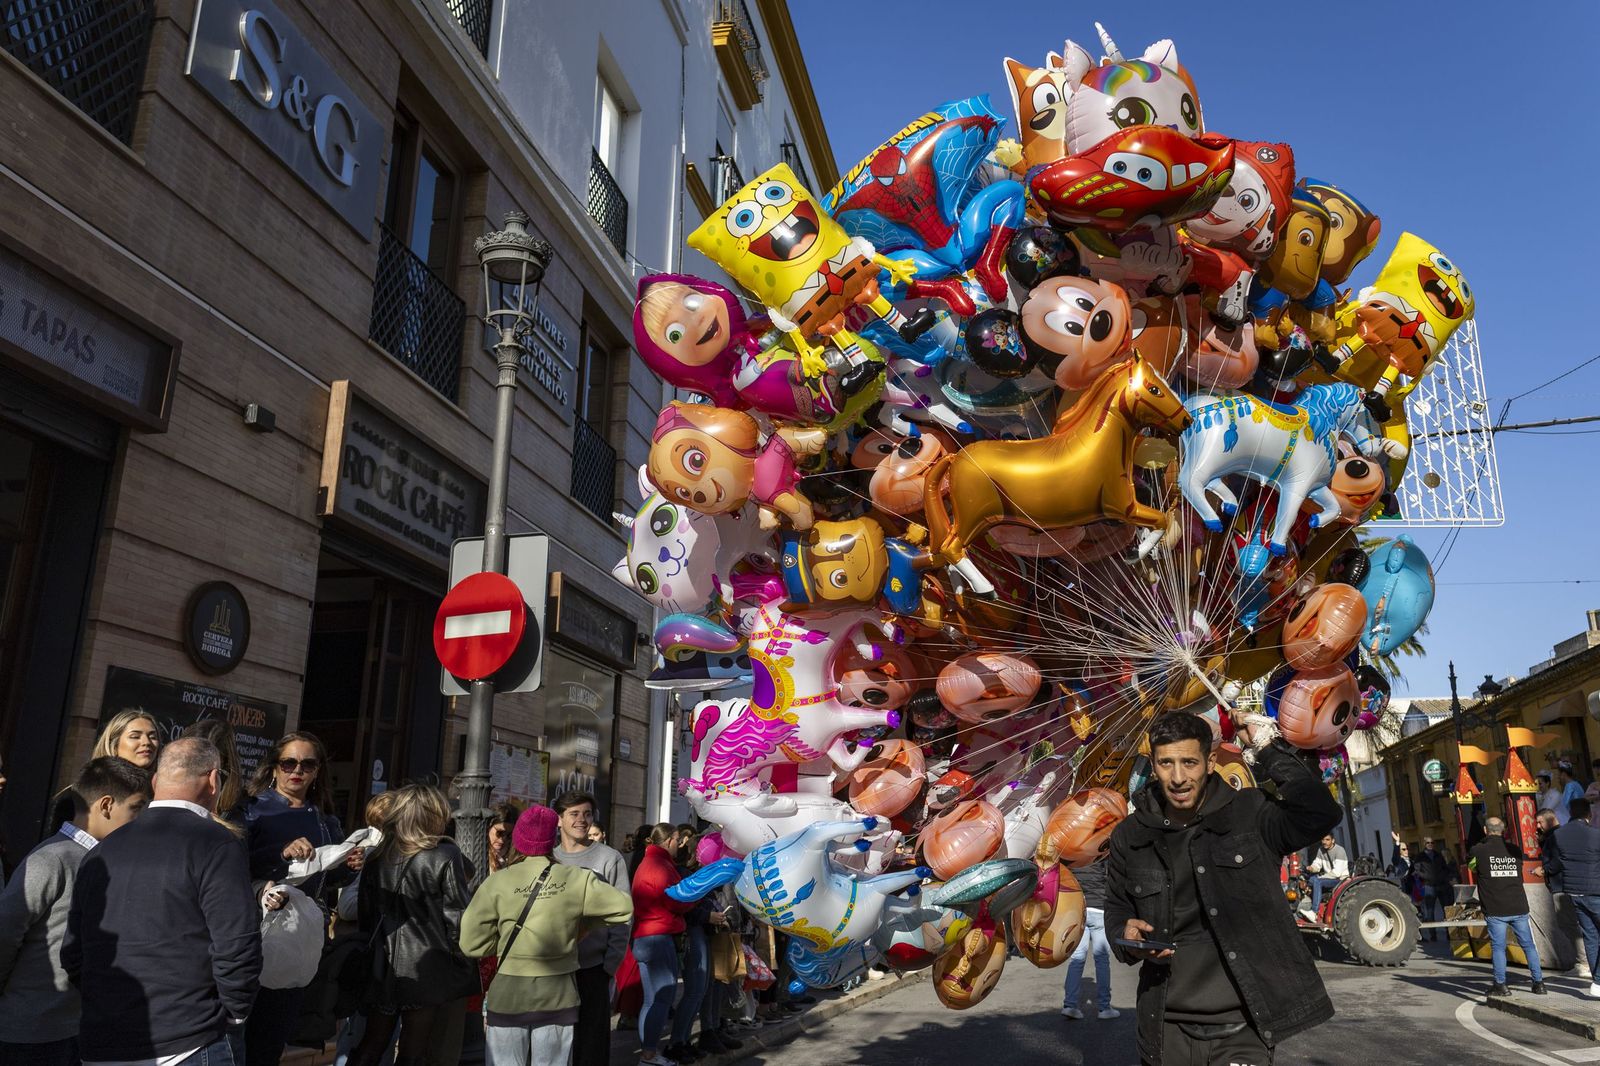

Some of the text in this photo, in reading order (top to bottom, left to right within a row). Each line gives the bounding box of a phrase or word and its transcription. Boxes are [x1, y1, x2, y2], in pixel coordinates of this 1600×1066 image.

[229, 9, 361, 188] S&G
[21, 298, 96, 364] TAPAS
[343, 445, 466, 540] ROCK CAFÉ
[204, 631, 233, 645] CERVEZA
[201, 643, 231, 658] BODEGA
[182, 690, 229, 711] ROCK CAFÉ
[1489, 856, 1516, 864] Equipo
[1490, 863, 1517, 871] técnico
